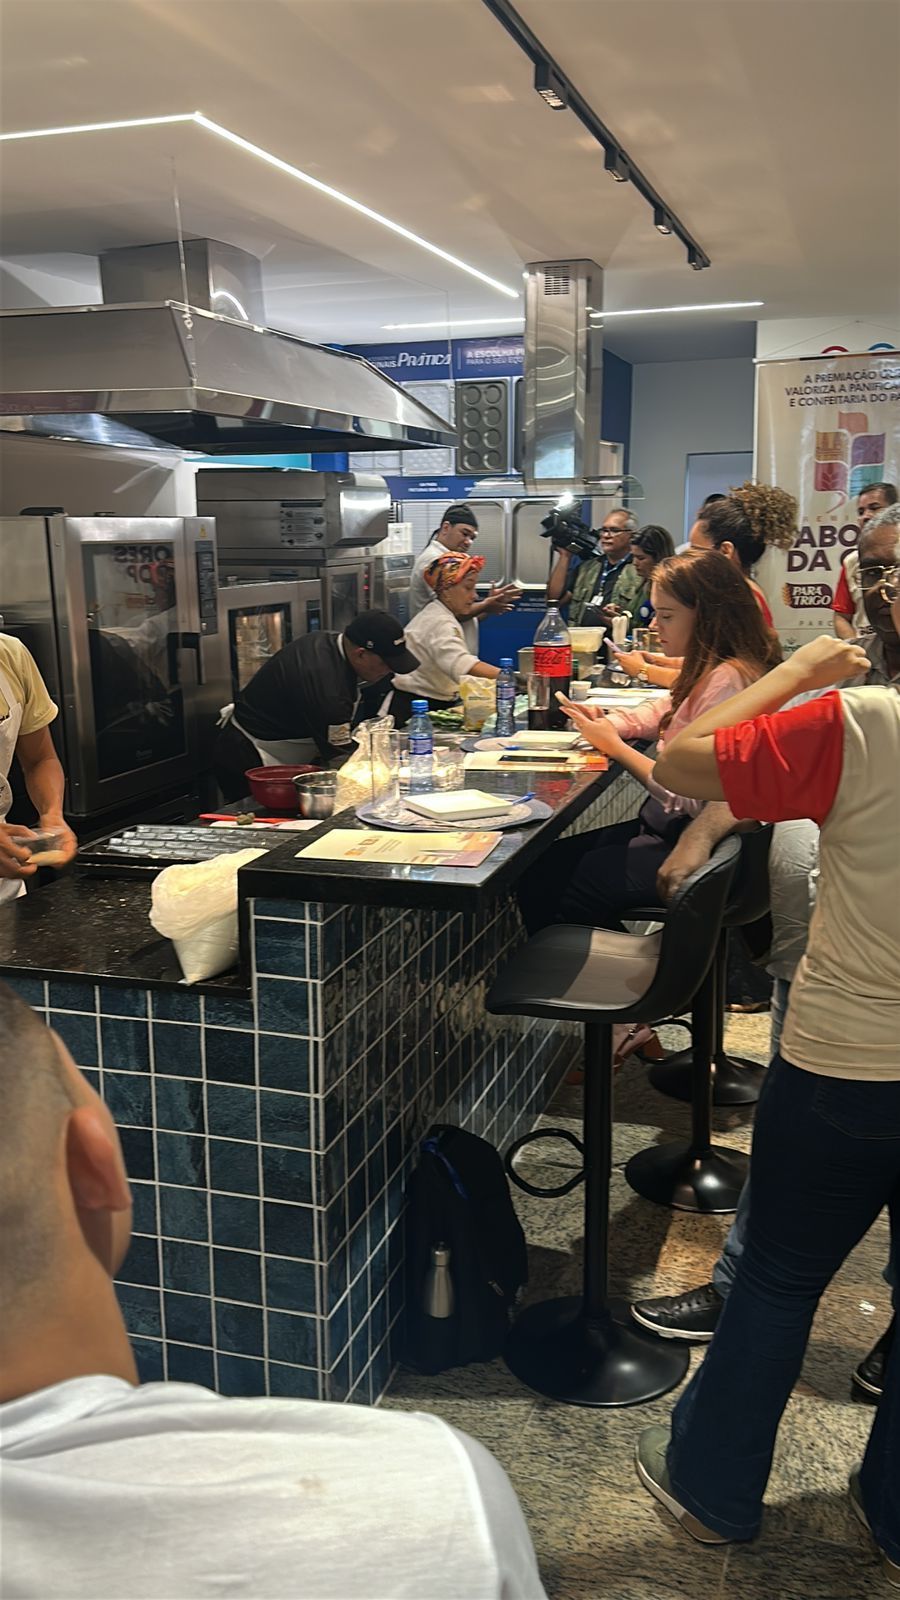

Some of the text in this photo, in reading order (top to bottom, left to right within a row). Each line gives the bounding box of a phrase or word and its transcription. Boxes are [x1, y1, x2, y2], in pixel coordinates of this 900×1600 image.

[804, 374, 812, 384] A
[815, 369, 877, 383] PREMIAÇÃO
[785, 386, 836, 396] VALORIZA
[838, 383, 847, 392] A
[790, 398, 796, 407] E
[798, 394, 868, 407] CONFEITARIA
[870, 393, 888, 402] DO
[794, 523, 860, 548] ABO
[787, 549, 832, 572] DA
[792, 586, 822, 596] PARA
[793, 595, 831, 605] TRIGO
